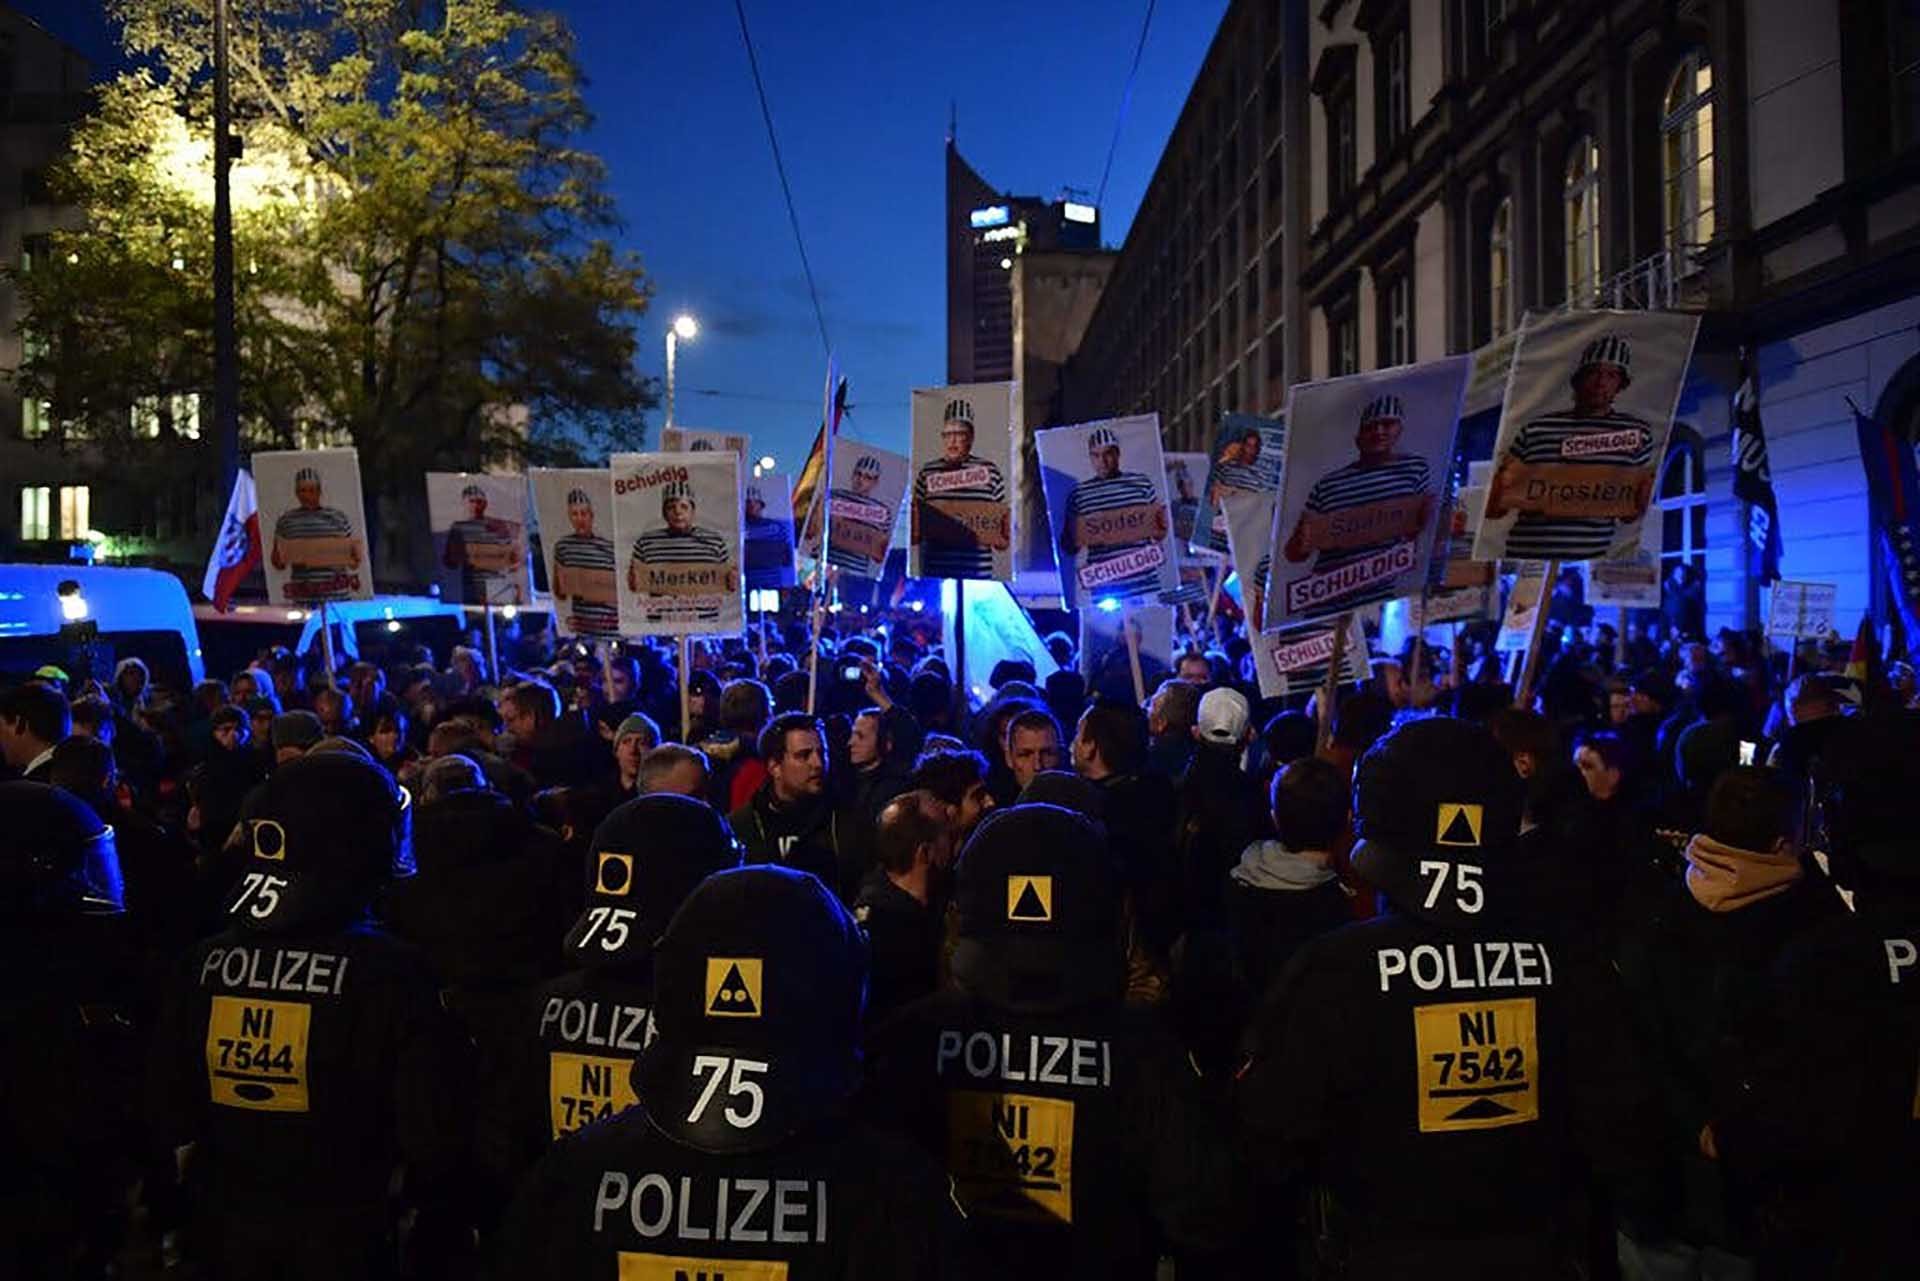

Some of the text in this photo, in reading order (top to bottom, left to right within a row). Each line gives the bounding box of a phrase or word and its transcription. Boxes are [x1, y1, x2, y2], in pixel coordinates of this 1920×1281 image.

[1563, 431, 1638, 453] SCHULDIG
[928, 467, 988, 488] SCHULDIG
[1528, 478, 1635, 501] Drosten
[1084, 550, 1161, 583] SCHULDIG
[1296, 548, 1410, 604] SCHULDIG
[1278, 632, 1348, 668] SCHULD
[229, 872, 287, 919] 75
[1420, 860, 1485, 914] 75
[578, 906, 637, 952] 75
[200, 947, 349, 995] POLIZEI
[1377, 942, 1553, 993] POLIZEI
[241, 1007, 274, 1039] NI
[1459, 1011, 1496, 1046] NI
[217, 1039, 294, 1073] 7544
[937, 1030, 1112, 1087] POLIZEI
[1433, 1047, 1524, 1085] 7542
[581, 1063, 612, 1098] NI
[687, 1055, 769, 1129] 75
[992, 1101, 1029, 1140] NI
[593, 1170, 828, 1243] POLIZEI
